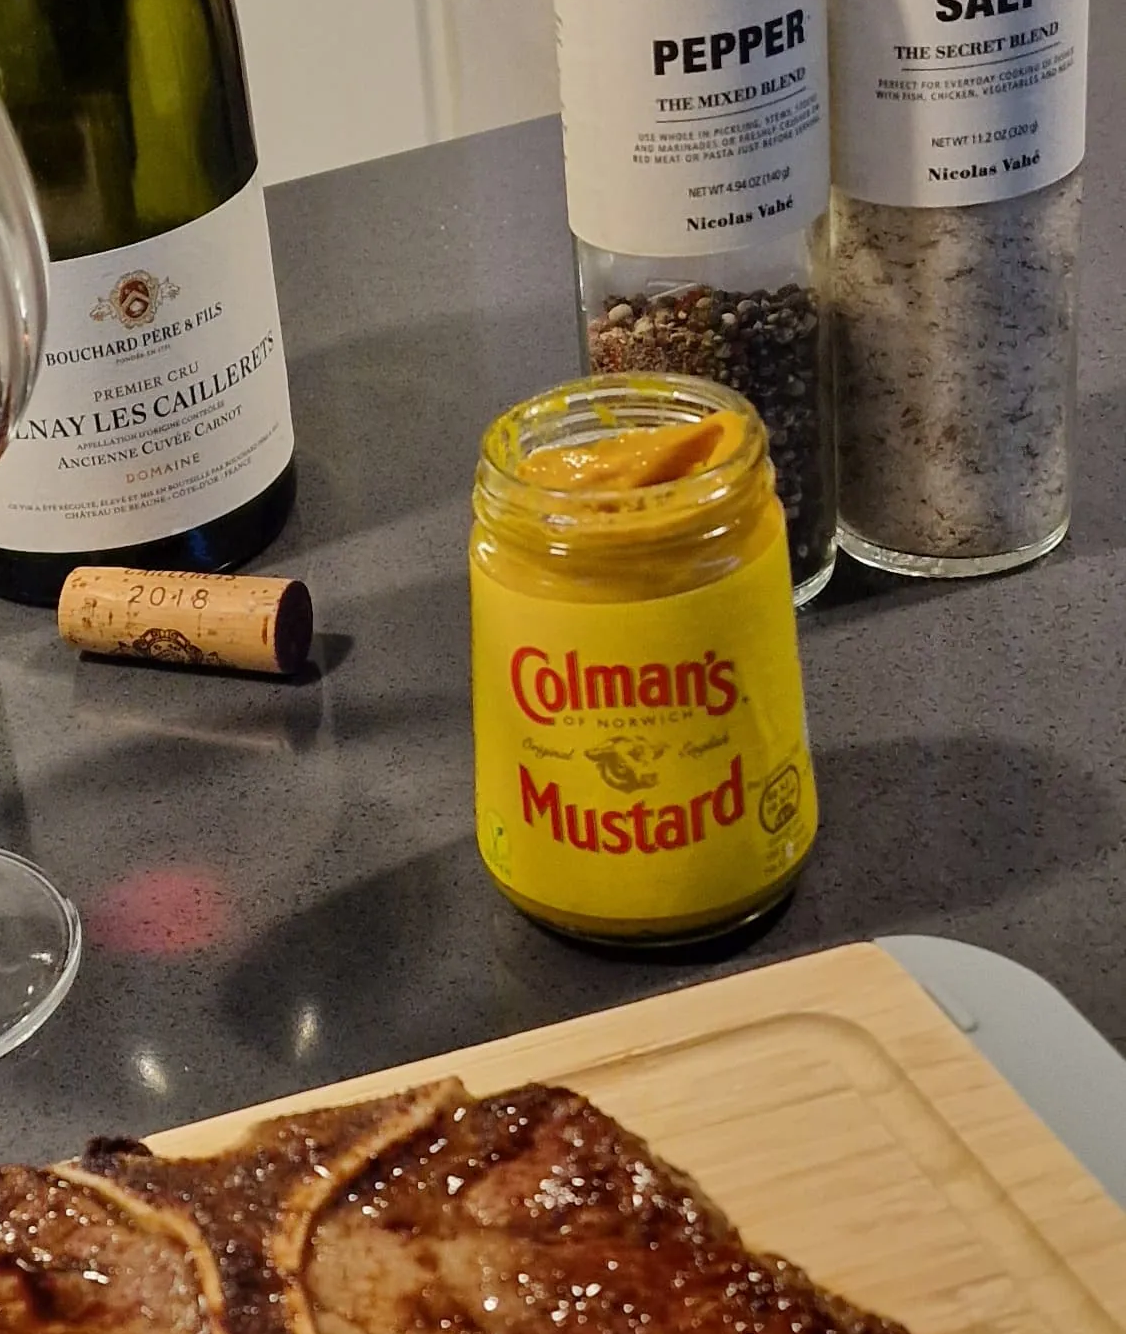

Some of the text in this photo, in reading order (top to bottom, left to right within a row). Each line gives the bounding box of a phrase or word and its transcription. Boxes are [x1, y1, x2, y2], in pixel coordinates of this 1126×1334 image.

[653, 9, 805, 76] PEPPER
[894, 21, 1059, 60] THE SECRET BLEND
[656, 67, 806, 112] THE MIXED BLEND
[921, 81, 940, 89] FOR
[944, 75, 995, 88] EVERYDAY
[634, 143, 654, 153] AND
[658, 140, 718, 153] MARINADES
[659, 131, 694, 142] WHOLE
[932, 137, 949, 148] NET
[951, 135, 969, 146] WT
[972, 132, 992, 144] 11.2
[994, 129, 1007, 141] OZ
[655, 154, 680, 164] MEAT
[685, 153, 699, 162] OR
[703, 148, 734, 160] PASTA
[738, 142, 759, 155] JUST
[928, 149, 1041, 181] Nicolas Vahé
[689, 186, 707, 198] NET
[709, 184, 724, 196] WT
[726, 181, 746, 194] 4.94
[749, 177, 760, 188] OZ
[686, 194, 794, 232] Nicolas Vahé
[45, 301, 223, 367] BOUCHARD PÈRE & FILS
[93, 361, 200, 402] PREMIER CRU
[93, 402, 147, 434] LES
[153, 330, 275, 417] CAILLERETS
[58, 448, 139, 469] ANCIENNE
[142, 430, 192, 455] CUVÉE
[194, 405, 242, 437] CARNOT
[77, 433, 137, 450] APPELLATION
[126, 452, 200, 484] DOMAINE
[114, 506, 126, 515] DE
[129, 495, 165, 511] BEAUNE
[128, 585, 209, 609] 2018
[510, 646, 739, 725] Colman's
[563, 710, 693, 728] OF NORWICH
[519, 754, 745, 854] Mustard
